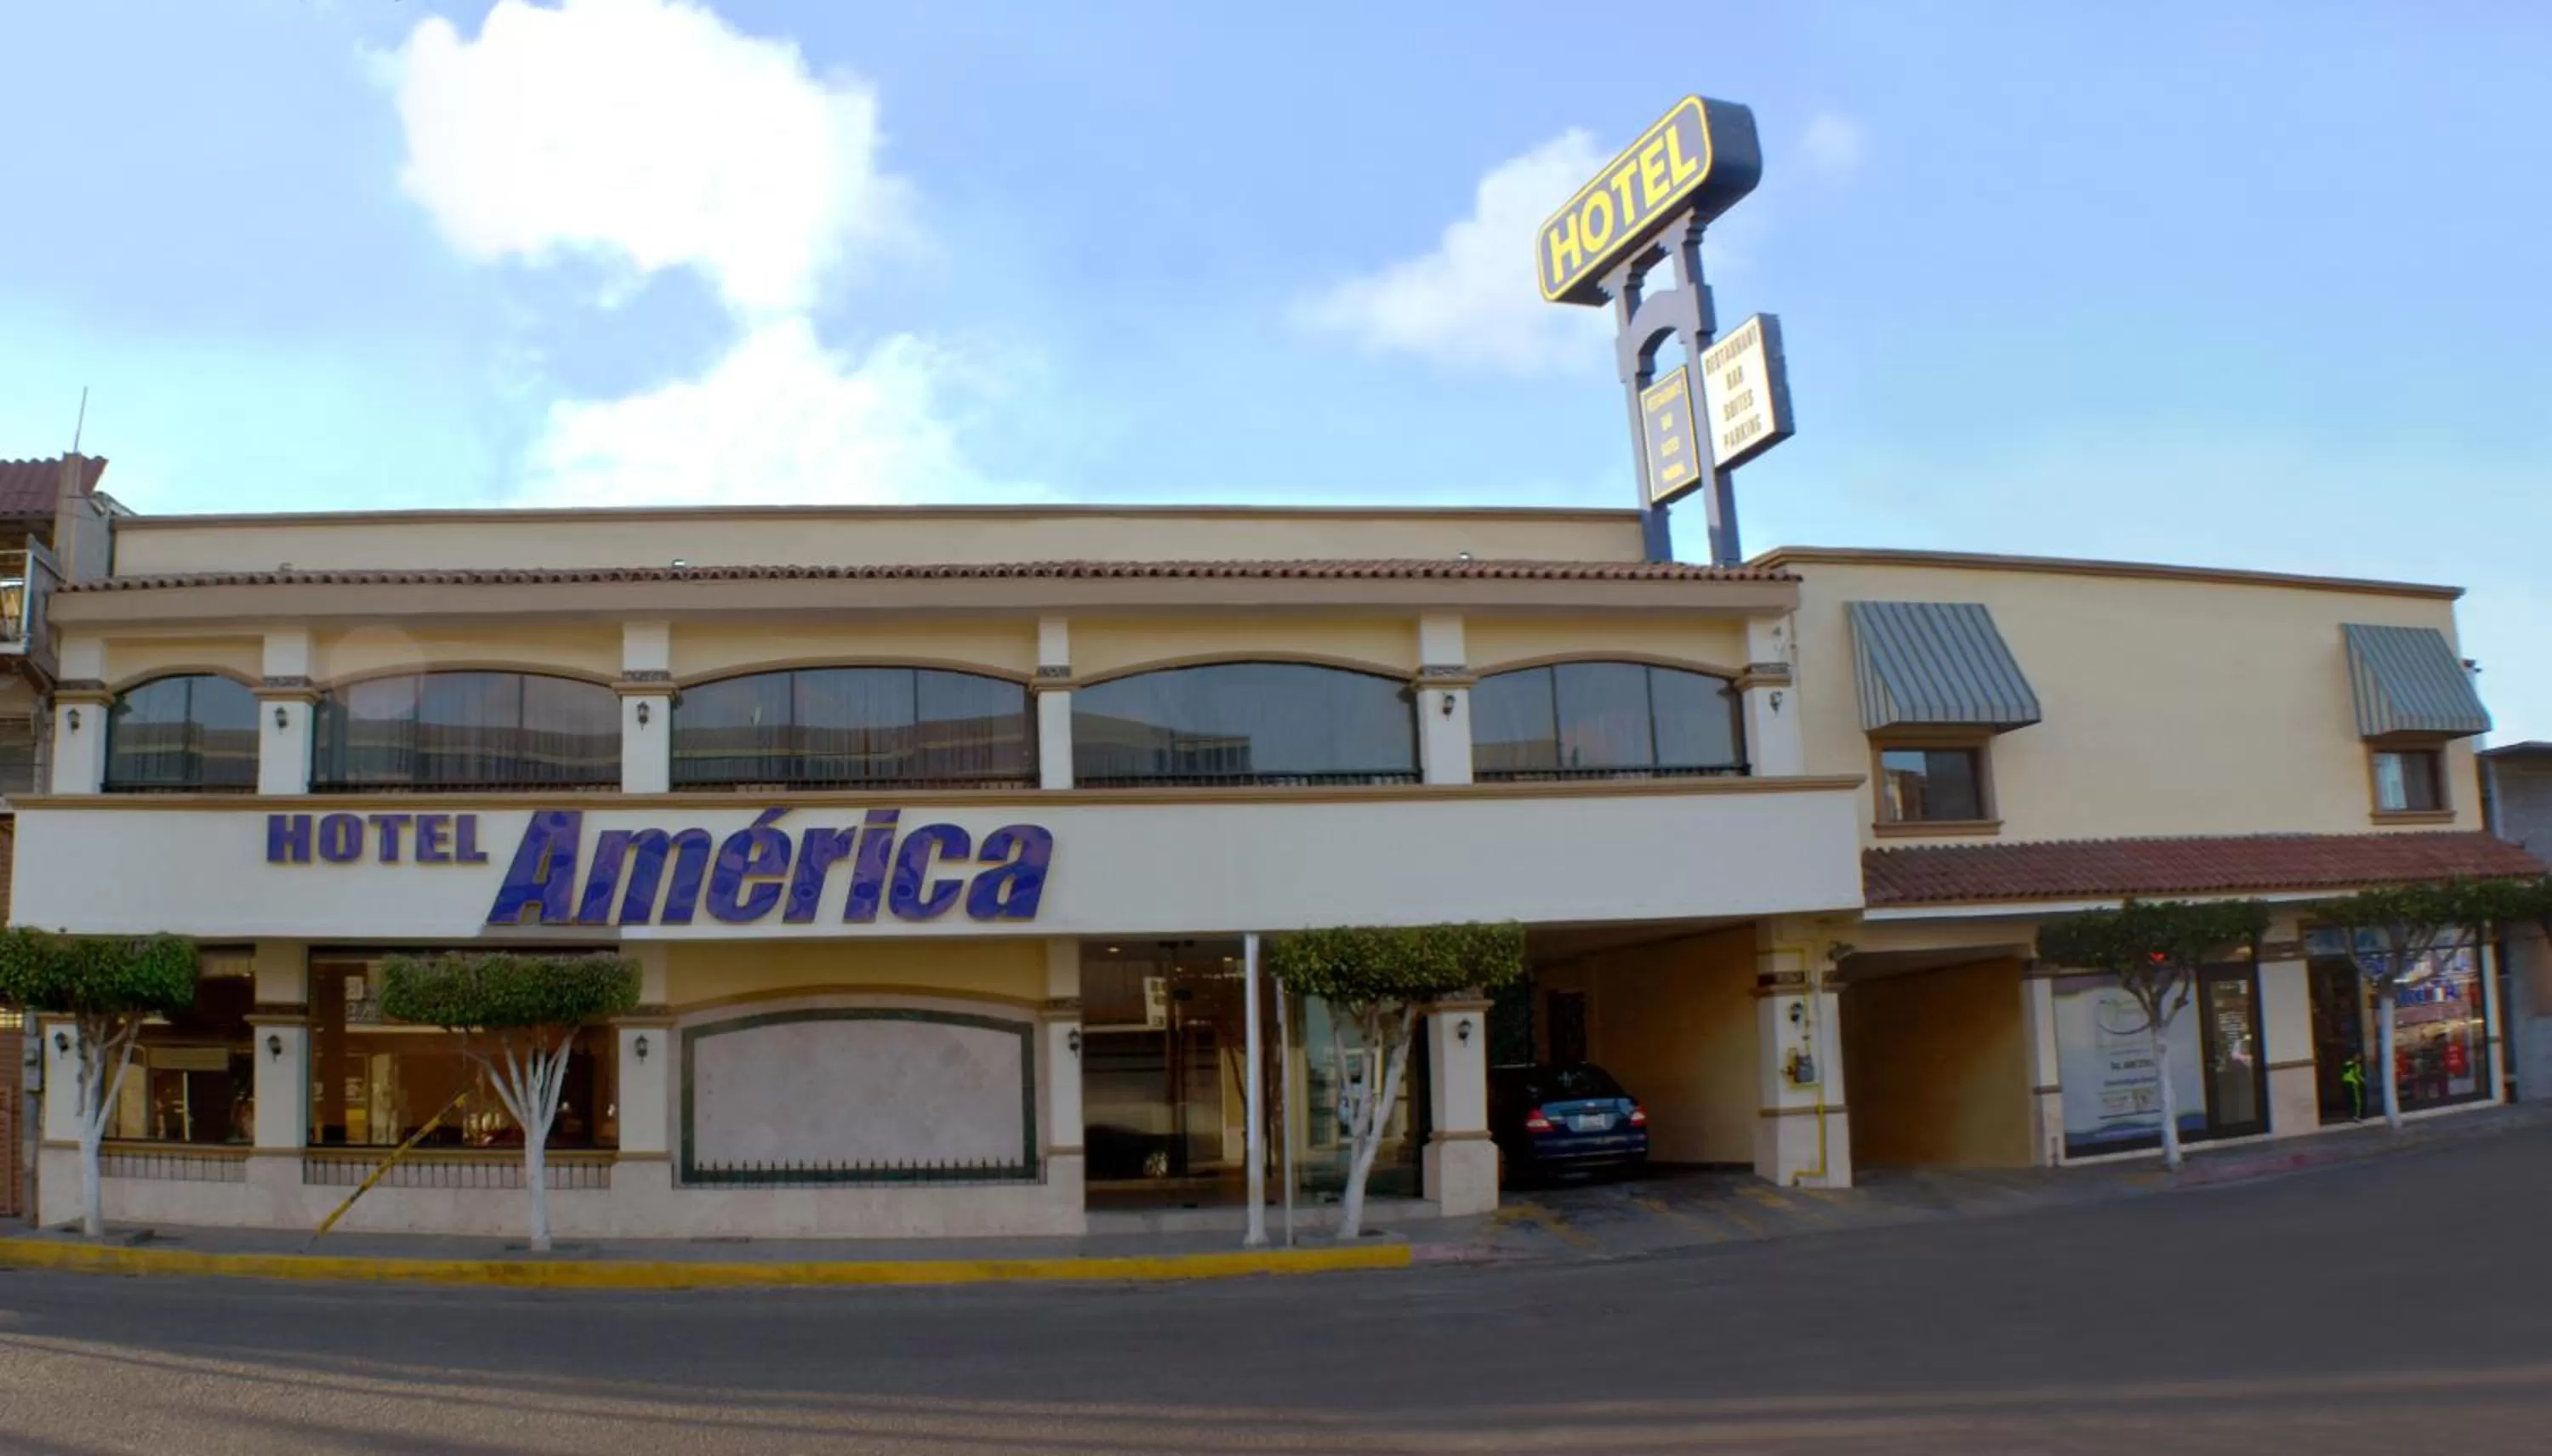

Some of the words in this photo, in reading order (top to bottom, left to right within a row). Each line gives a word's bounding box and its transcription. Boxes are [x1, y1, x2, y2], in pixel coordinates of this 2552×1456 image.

[1548, 124, 1697, 284] HOTEL
[1706, 324, 1757, 374] RESTAURANT
[1726, 365, 1743, 390] BAR
[1723, 388, 1753, 422] SUITES
[1723, 413, 1761, 448] PARKING
[266, 813, 490, 865] HOTEL
[487, 806, 1052, 925] América
